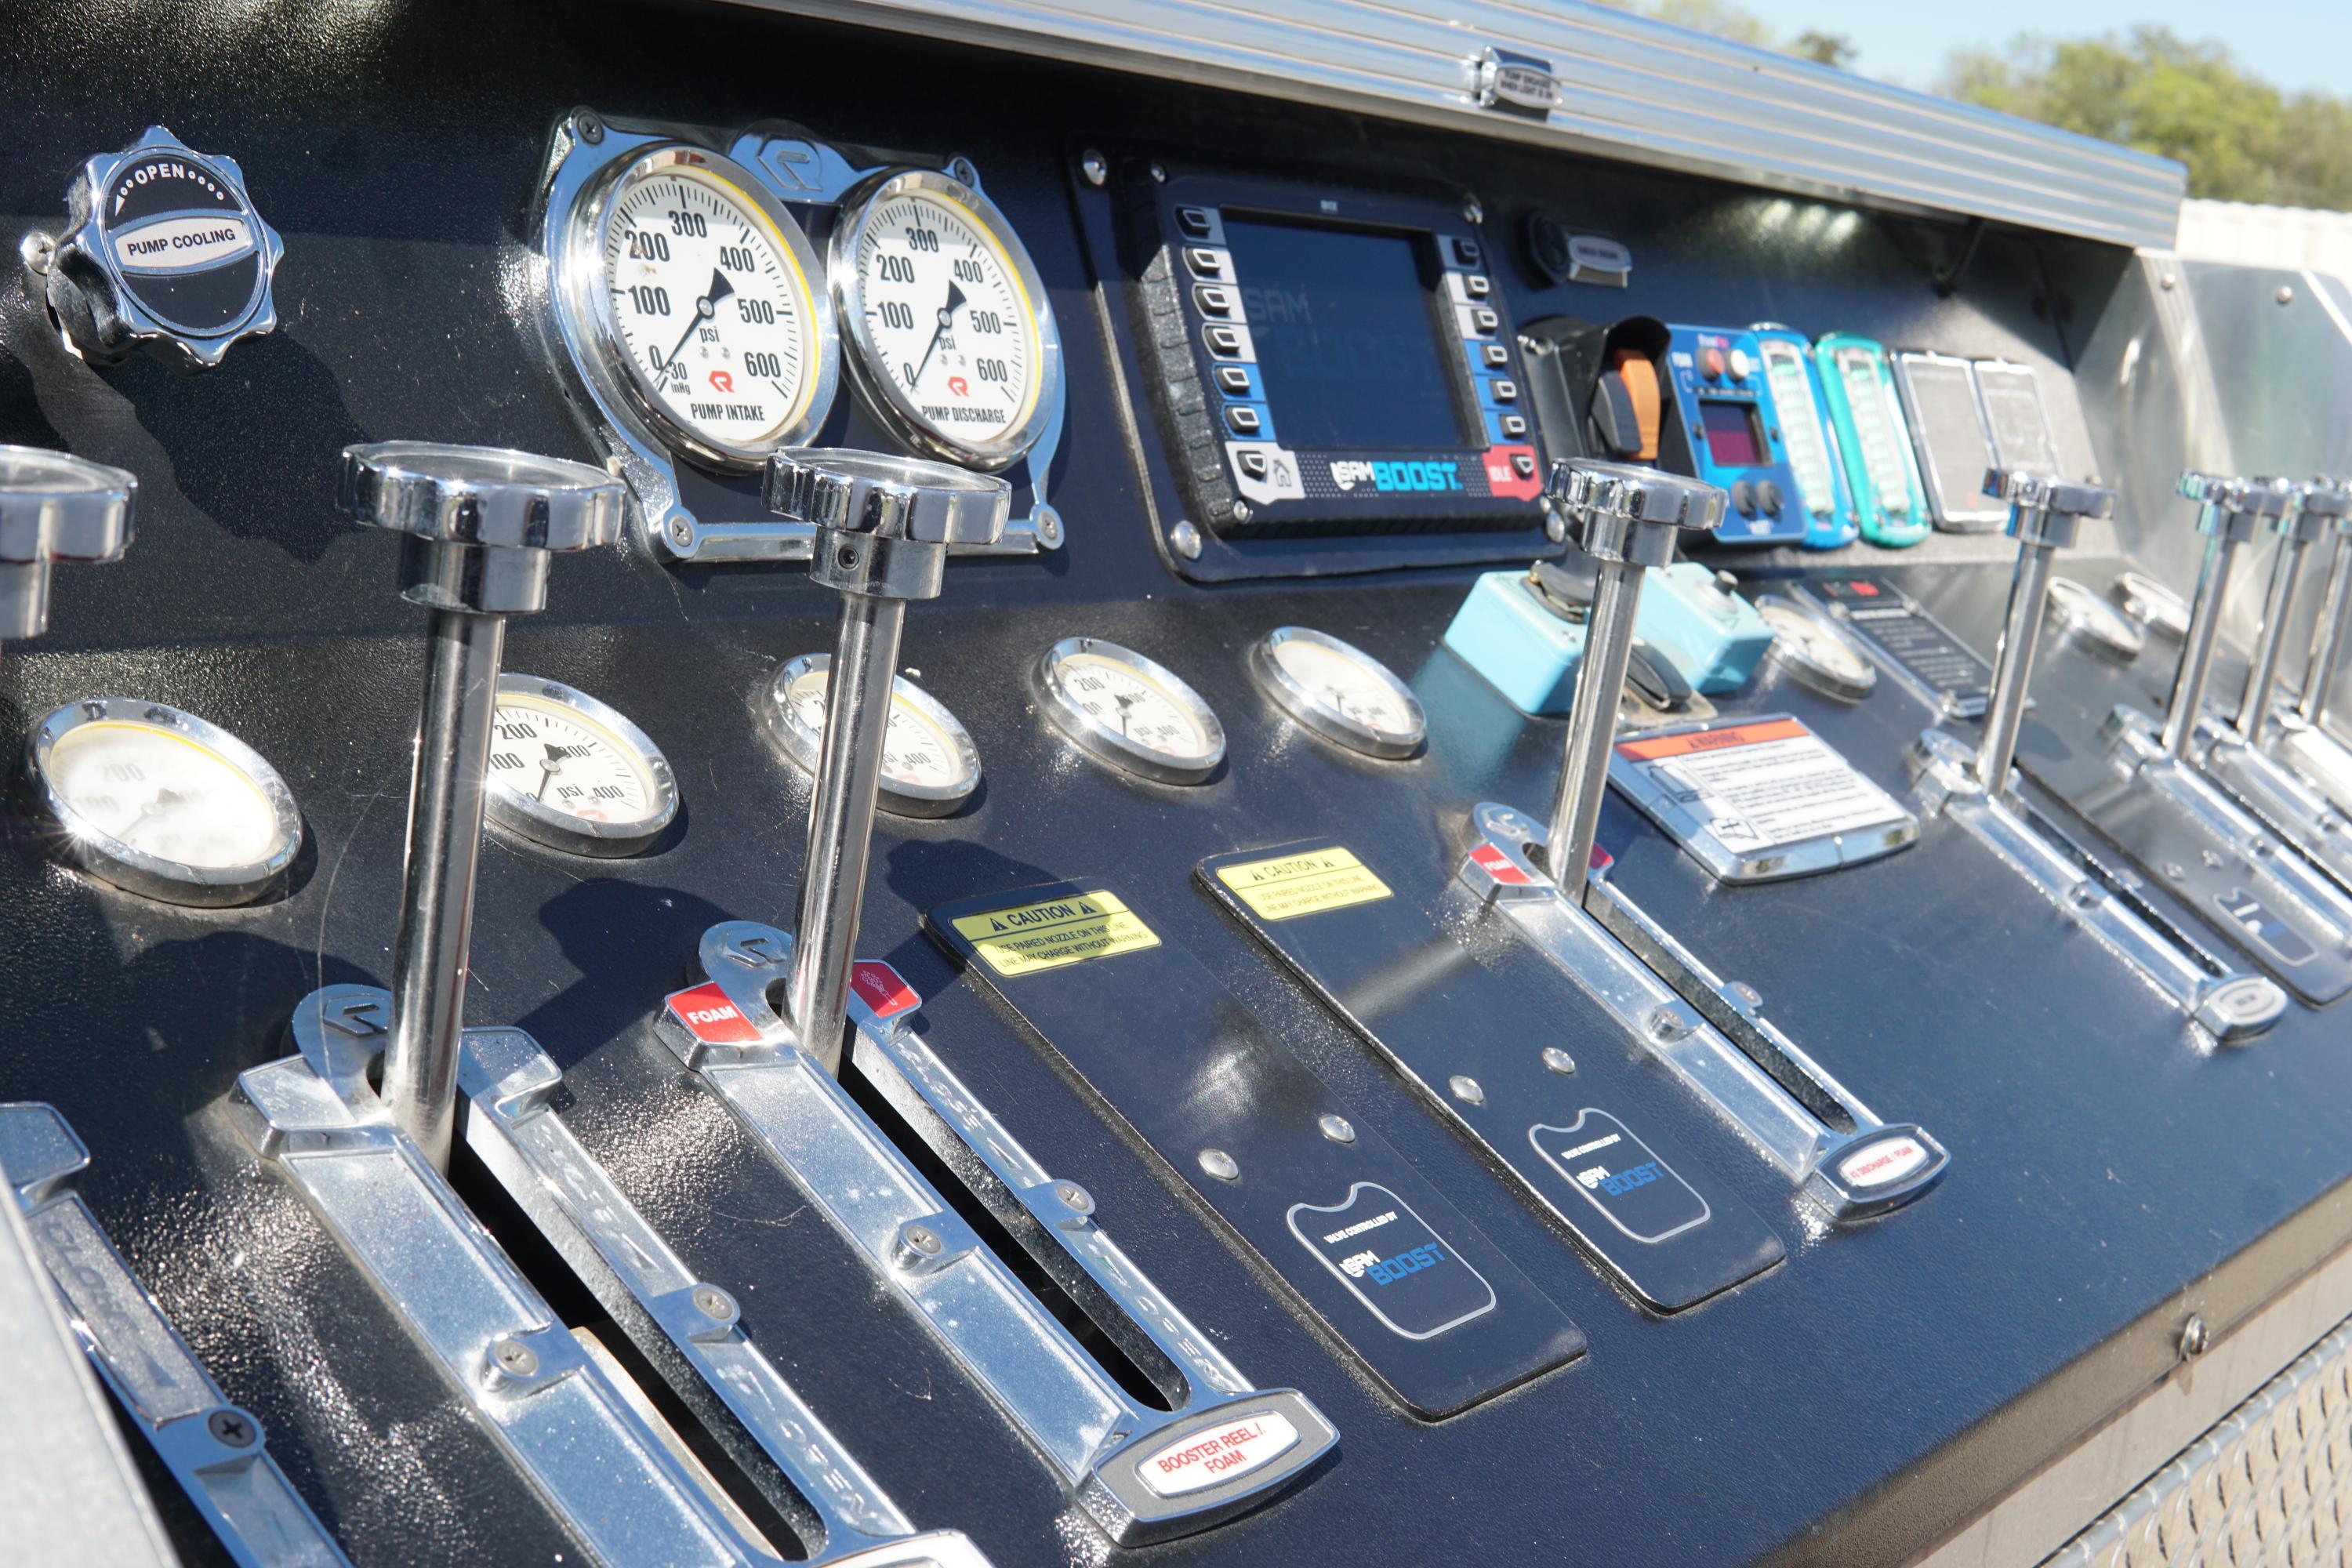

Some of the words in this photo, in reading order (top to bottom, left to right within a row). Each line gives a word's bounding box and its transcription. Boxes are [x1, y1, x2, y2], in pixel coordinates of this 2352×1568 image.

[134, 163, 185, 185] OPEN
[668, 210, 708, 238] 300
[127, 238, 169, 256] PUMP
[172, 228, 237, 249] COOLING
[624, 230, 670, 262] 200
[905, 227, 940, 253] 300
[720, 245, 756, 273] 400
[876, 253, 916, 284] 200
[953, 259, 984, 284] 400
[627, 285, 671, 316] 100
[736, 298, 775, 325] 500
[877, 300, 915, 330] 100
[970, 309, 1002, 335] 500
[699, 325, 720, 343] psi
[938, 335, 957, 351] psi
[648, 345, 665, 371] 0
[744, 351, 782, 378] 600
[976, 358, 1008, 383] 600
[902, 361, 916, 386] 0
[670, 382, 691, 396] inHg
[690, 403, 724, 420] PUMP
[725, 404, 765, 421] INTAKE
[921, 405, 950, 422] PUMP
[951, 407, 1007, 424] DISCHARGE
[1073, 677, 1105, 692] 200
[494, 722, 538, 740] 200
[903, 752, 940, 765] 400
[556, 783, 585, 797] psi
[592, 785, 626, 800] 400
[1264, 859, 1317, 877] CAUTION
[1006, 904, 1076, 927] CAUTION
[995, 940, 1016, 954] USE
[1014, 934, 1049, 952] PAIRED
[1047, 931, 1080, 946] NOZZLE
[1078, 927, 1092, 938] ON
[1091, 924, 1111, 935] THIS
[1109, 920, 1130, 931] LINE
[998, 956, 1022, 968] LINE
[1019, 953, 1038, 964] MAY
[1037, 946, 1076, 960] CHARGE
[1074, 937, 1115, 953] WITHOUT
[1112, 931, 1149, 946] WARNING
[686, 1005, 739, 1025] FOAM
[1598, 1160, 1664, 1196] BOOST
[1323, 1229, 1349, 1244] VALVE
[1345, 1214, 1389, 1236] CONTROLLED
[1385, 1210, 1398, 1221] BY
[1341, 1250, 1381, 1272] SAM
[1366, 1241, 1446, 1287] BOOST
[1157, 1439, 1223, 1473] BOOSTER
[1218, 1427, 1258, 1449] REEL
[1203, 1449, 1247, 1474] FOAM
